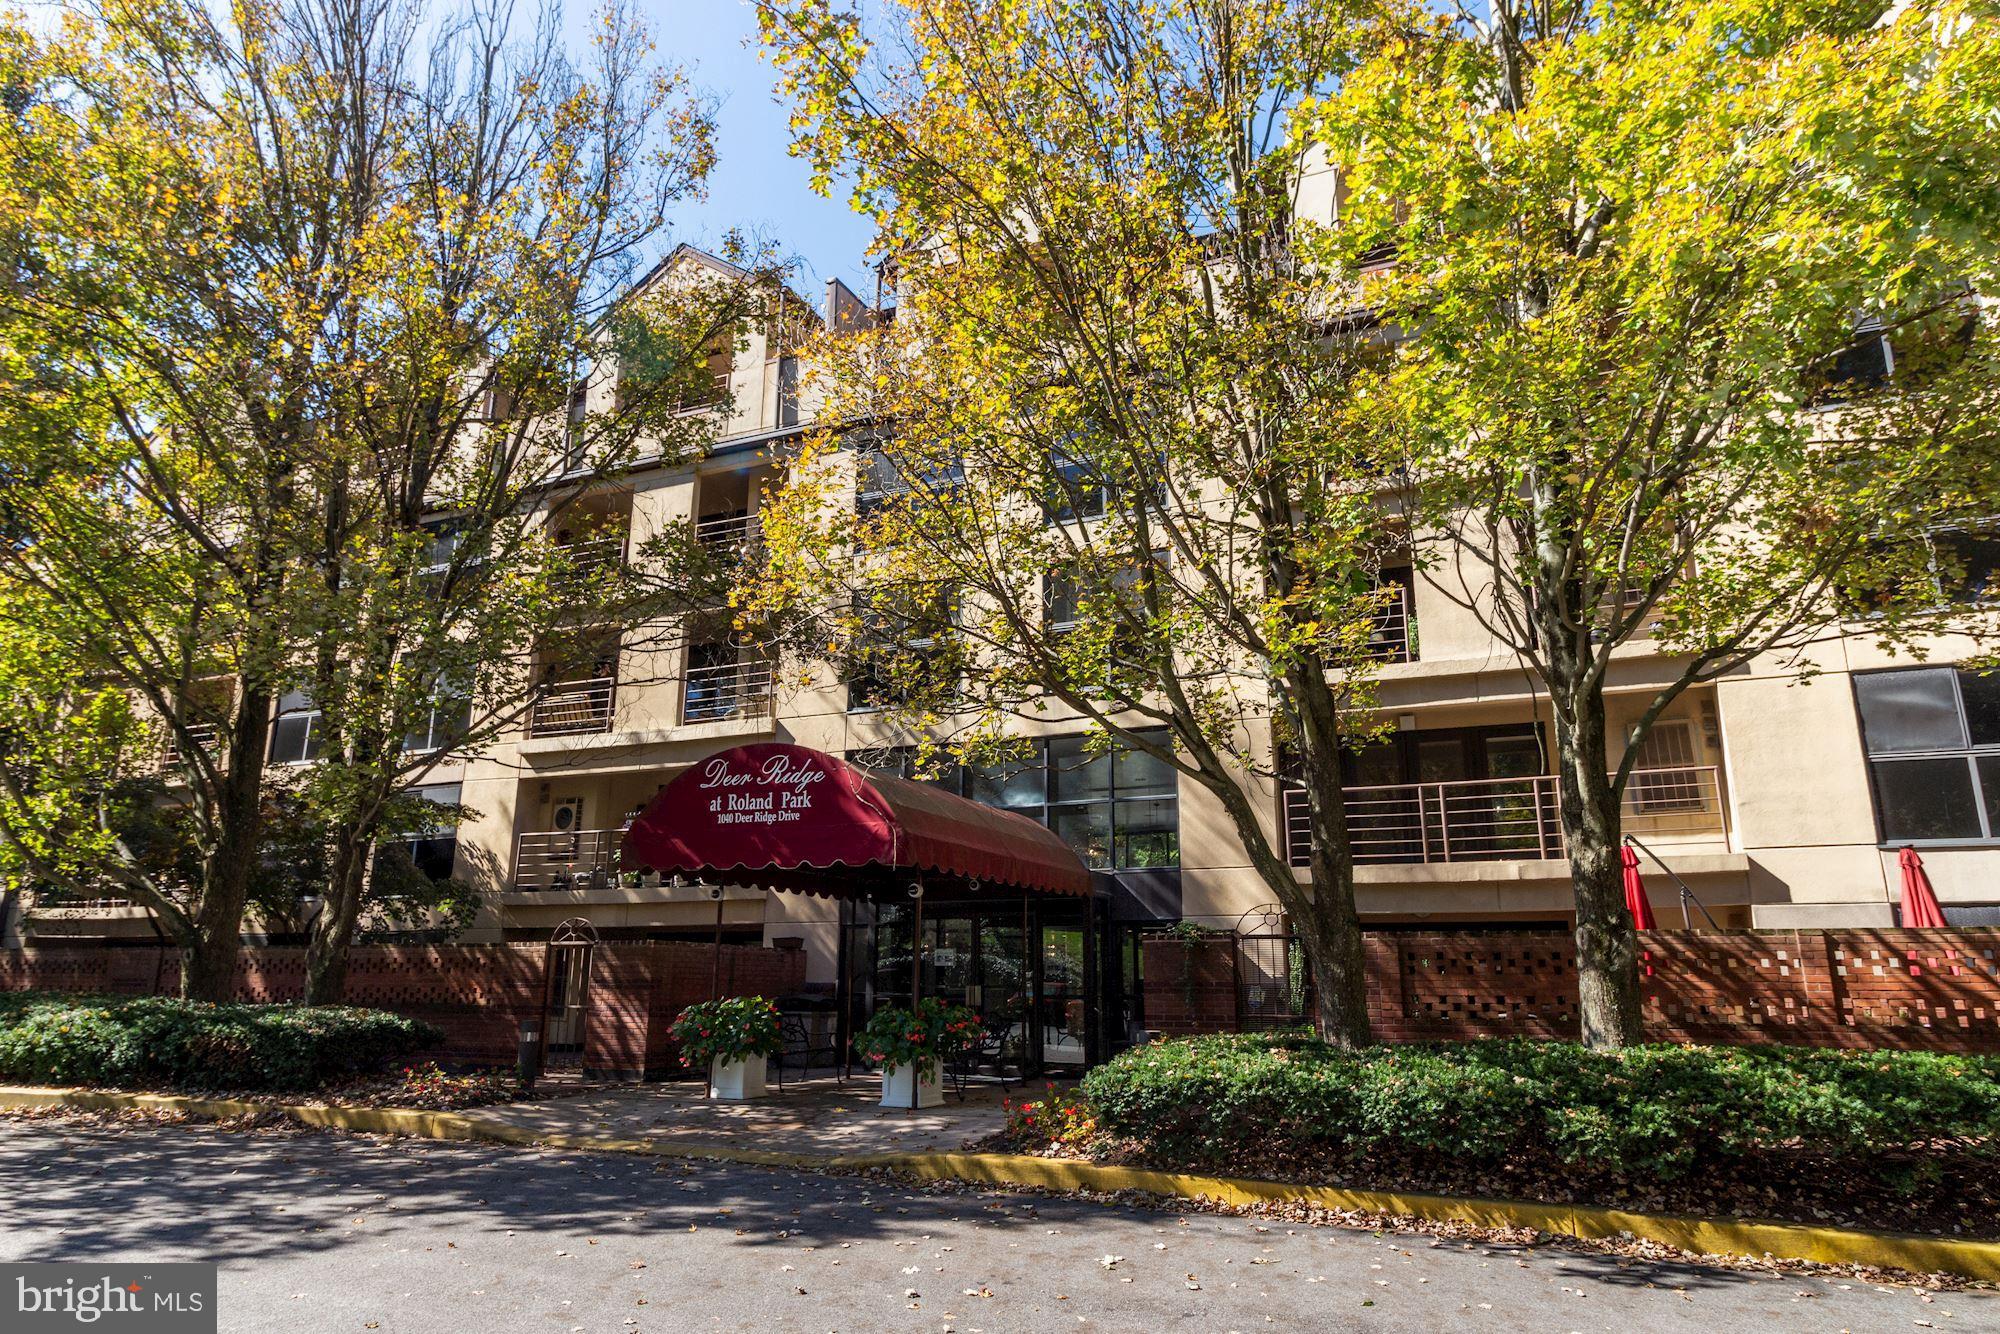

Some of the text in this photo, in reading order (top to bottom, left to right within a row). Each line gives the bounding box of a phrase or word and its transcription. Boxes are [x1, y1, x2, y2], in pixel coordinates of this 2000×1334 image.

[700, 754, 826, 793] Deer Ridge
[710, 790, 812, 811] at Roland Park
[717, 809, 800, 825] 1040 Deer Ridge Drive
